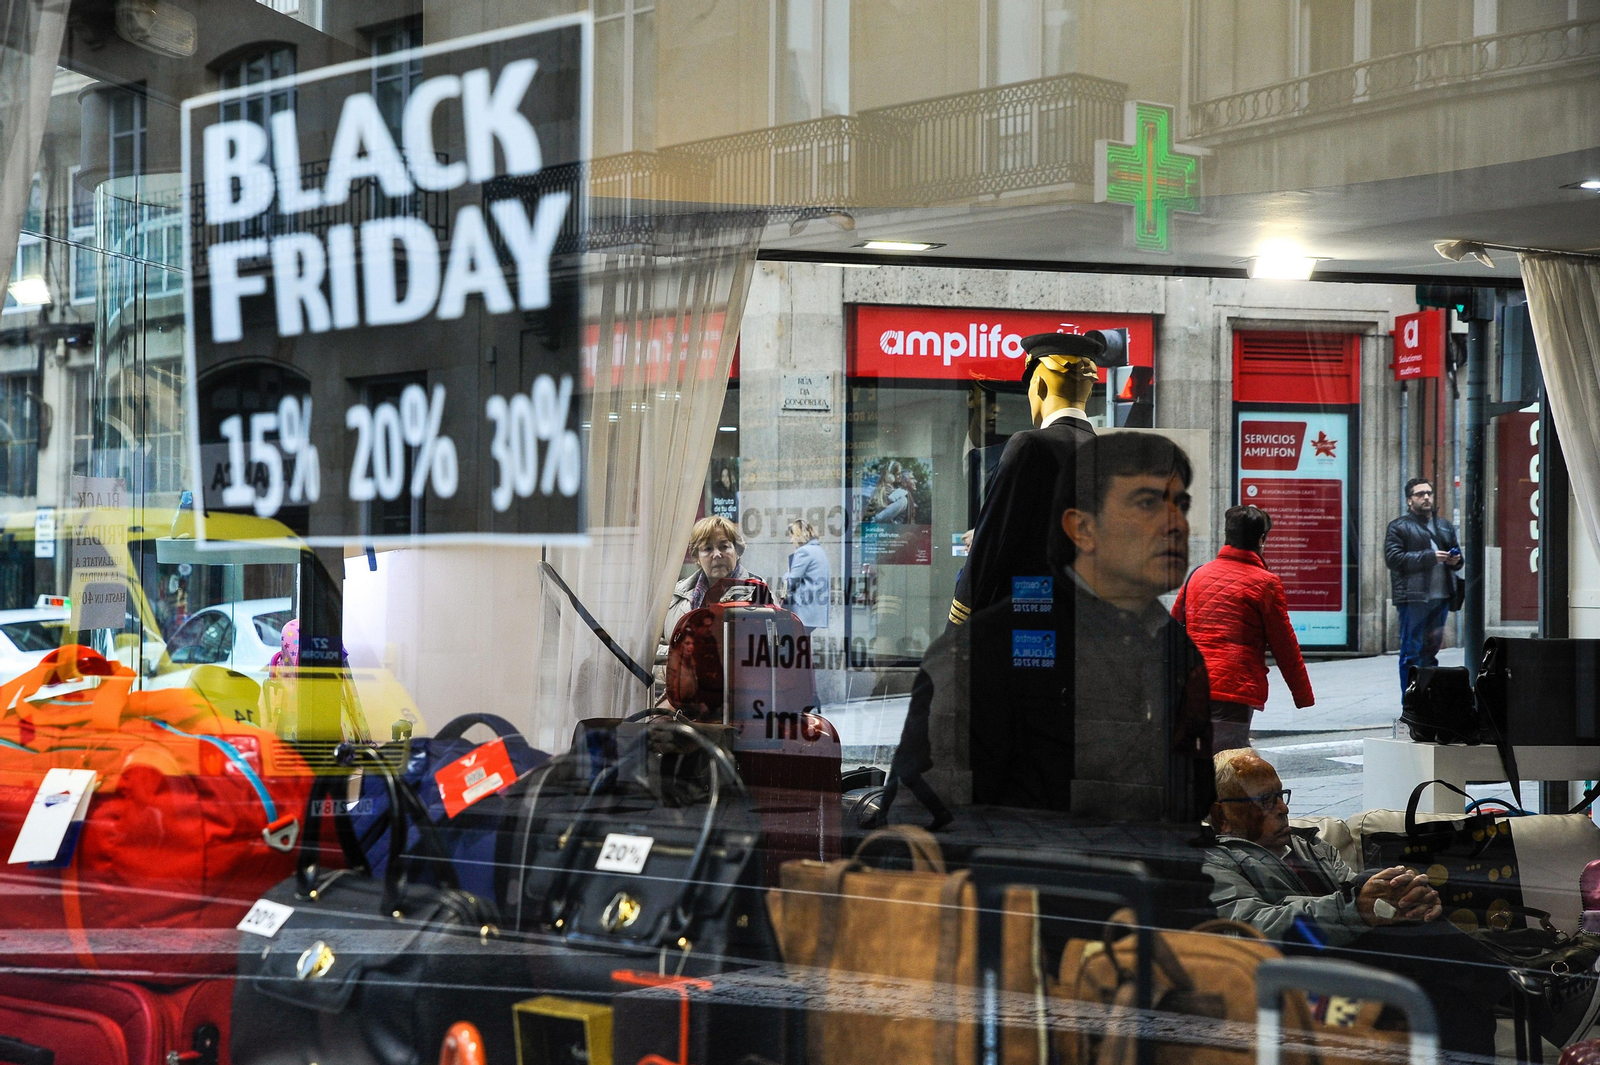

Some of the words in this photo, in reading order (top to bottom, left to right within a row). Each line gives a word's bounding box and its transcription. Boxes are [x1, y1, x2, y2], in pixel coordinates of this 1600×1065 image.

[202, 57, 543, 226] BLACK
[207, 191, 572, 344] FRIDAY
[879, 322, 1026, 367] amplifo
[1399, 354, 1423, 364] Soluciones
[1400, 366, 1421, 376] auditivas
[797, 376, 813, 385] RÚA
[799, 388, 810, 396] DA
[784, 398, 827, 406] CONCORDIA
[1244, 434, 1296, 445] SERVICIOS
[219, 394, 322, 519] 15%
[345, 383, 460, 503] 20%
[485, 373, 581, 513] 30%
[1244, 447, 1296, 458] AMPLIFON
[713, 497, 735, 505] Disfruta
[603, 843, 640, 864] 20%
[246, 908, 276, 929] 20%
